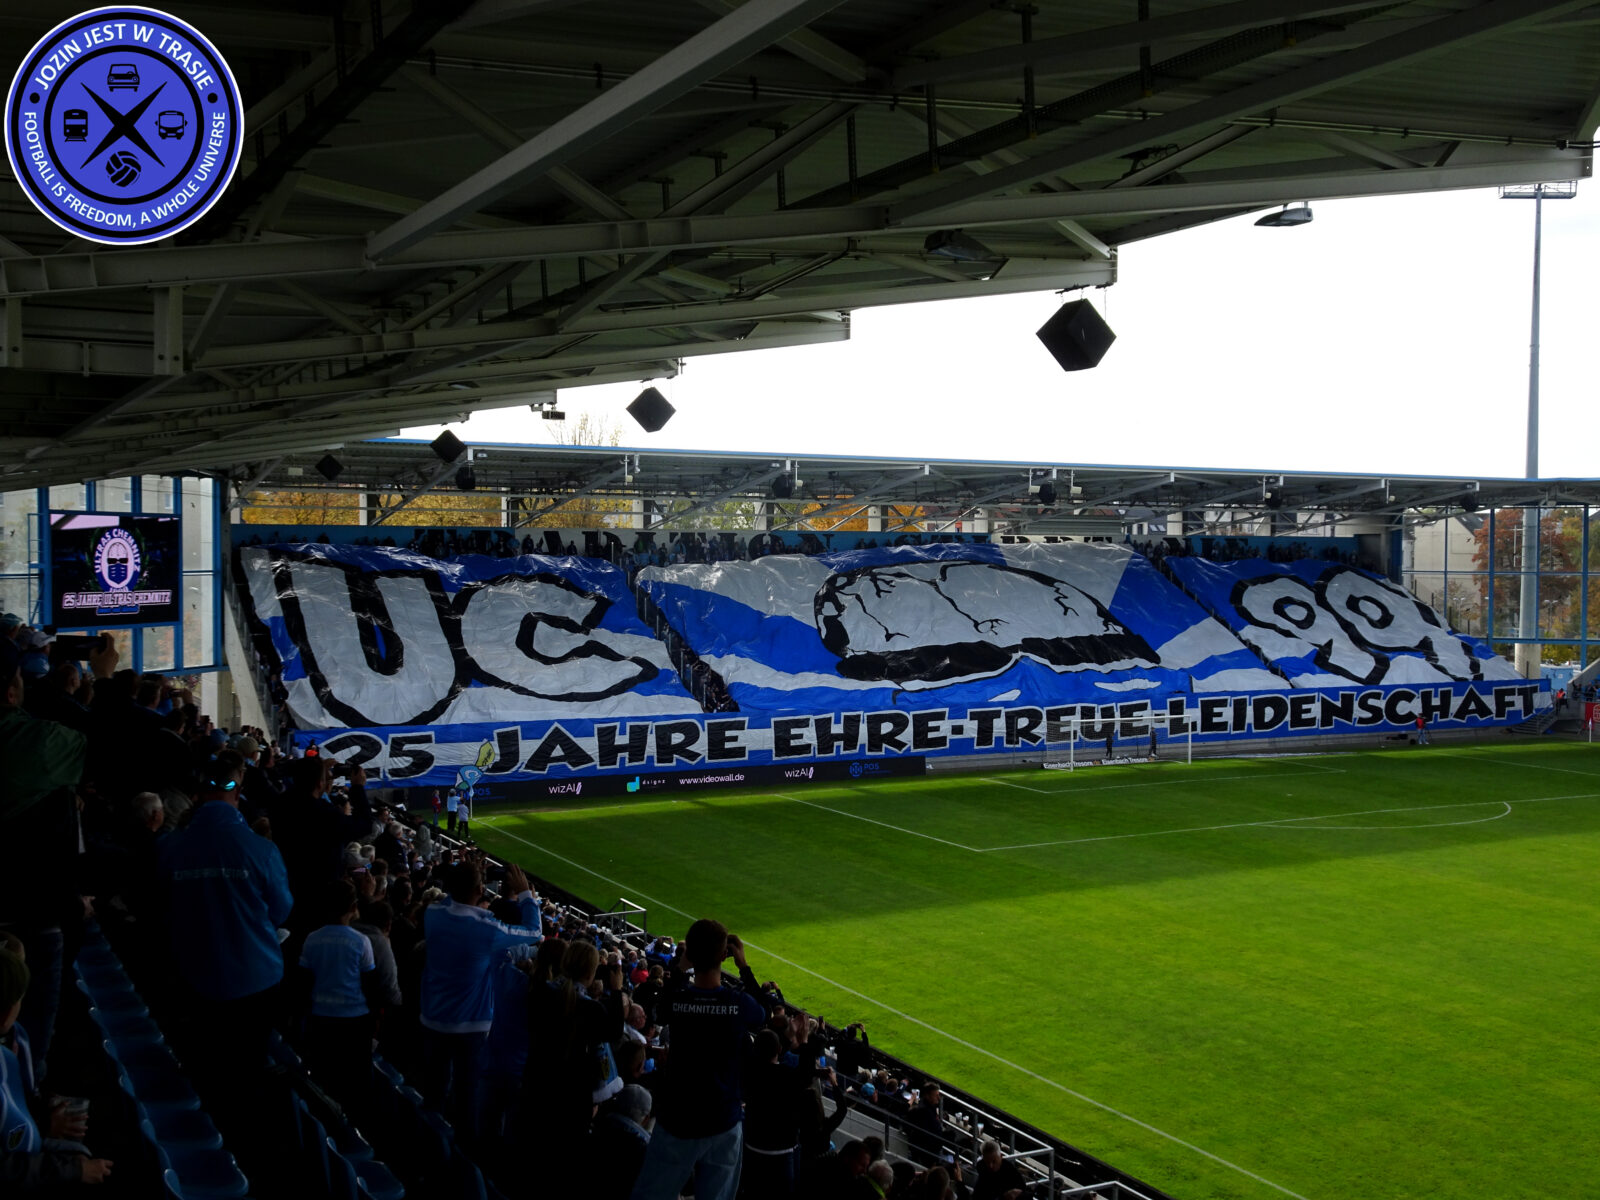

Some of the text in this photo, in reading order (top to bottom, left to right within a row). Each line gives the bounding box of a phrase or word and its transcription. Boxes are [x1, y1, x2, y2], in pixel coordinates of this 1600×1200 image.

[94, 528, 141, 573] ULTRAS CHEMNITZ
[269, 550, 659, 726] UC
[321, 732, 435, 780] 25
[486, 717, 748, 774] JAHRE
[679, 774, 745, 785] www.videowall.de
[672, 1002, 739, 1015] CHEMNITZER FC
